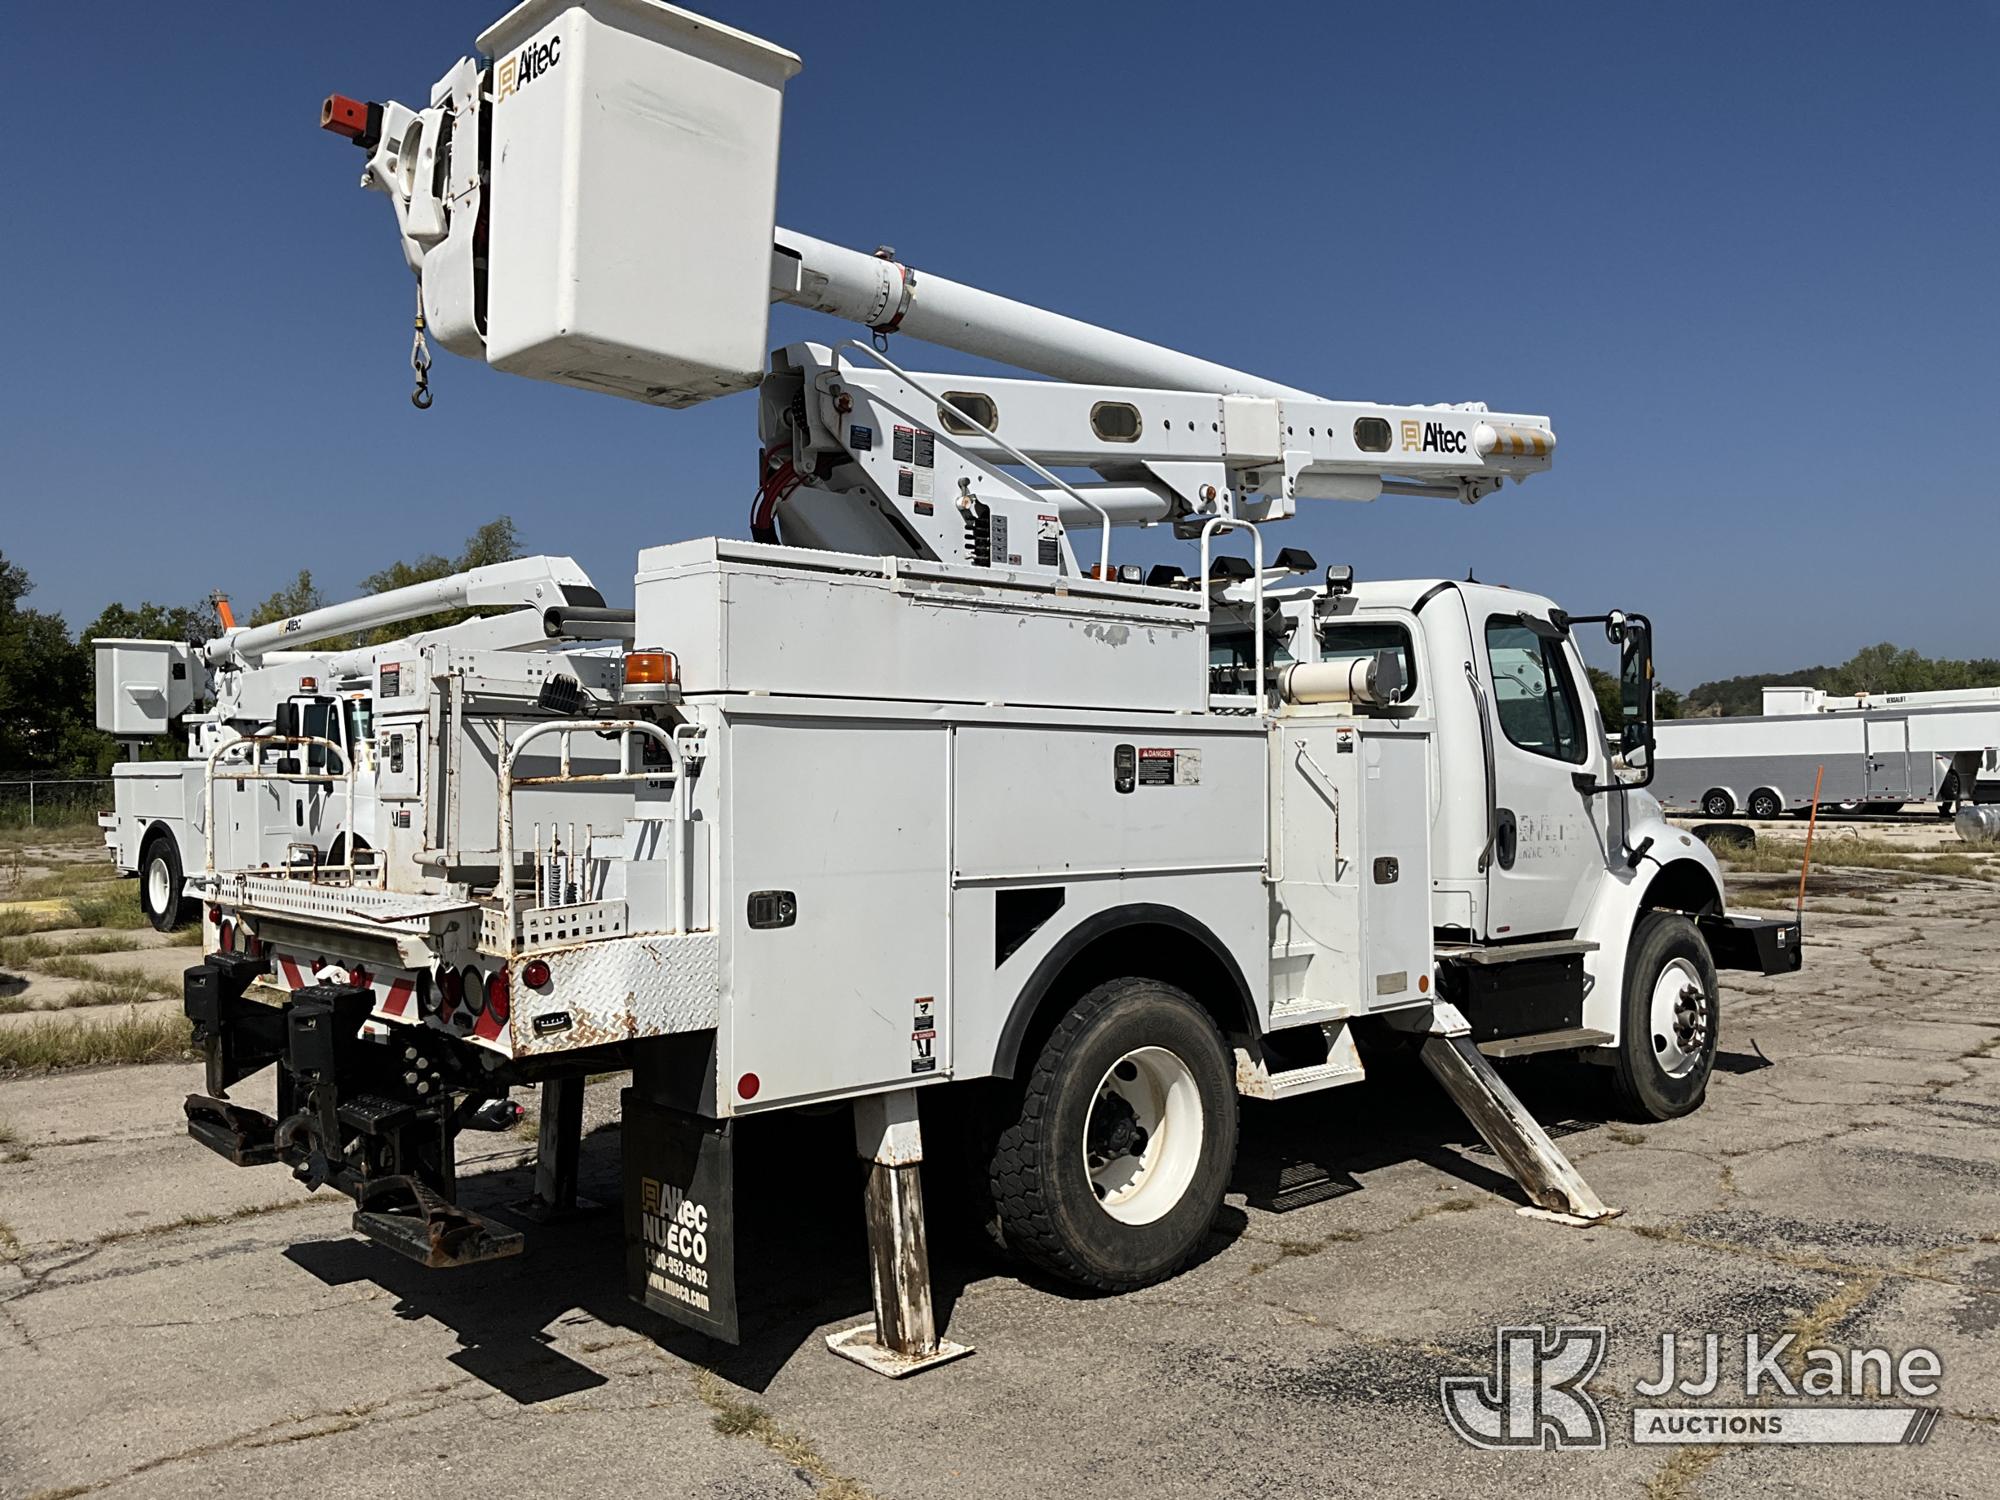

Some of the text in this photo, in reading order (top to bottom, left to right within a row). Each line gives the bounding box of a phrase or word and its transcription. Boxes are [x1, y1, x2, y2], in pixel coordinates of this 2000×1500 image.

[516, 35, 561, 92] Altec
[1422, 422, 1467, 454] Altec
[1148, 750, 1171, 758] DANGER
[660, 1183, 708, 1234] Altec
[643, 1212, 707, 1265] NUECO
